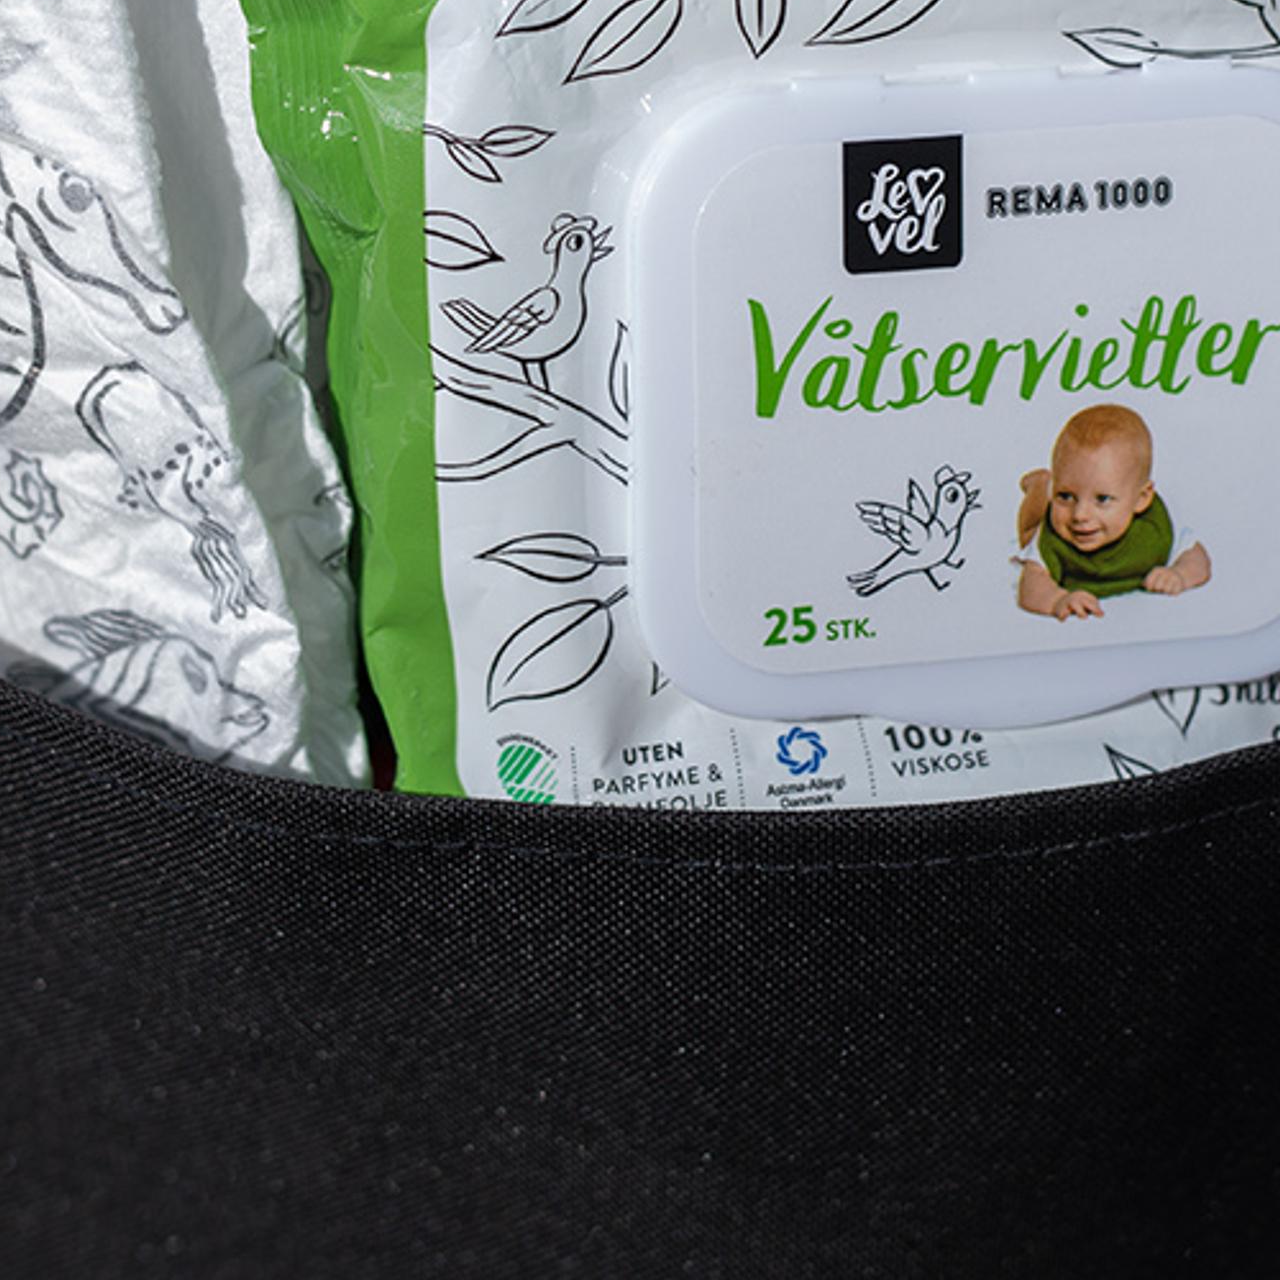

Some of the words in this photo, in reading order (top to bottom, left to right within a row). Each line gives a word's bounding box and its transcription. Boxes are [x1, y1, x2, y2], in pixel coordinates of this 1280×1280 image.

[985, 182, 1088, 219] REMA
[1093, 175, 1174, 211] 1000
[763, 605, 818, 647] 25
[825, 618, 877, 641] STK.
[884, 723, 984, 752] 100%
[622, 741, 685, 766] UTEN
[890, 749, 991, 777] VISKOSE
[592, 765, 701, 795] PARFYME
[707, 762, 723, 783] &
